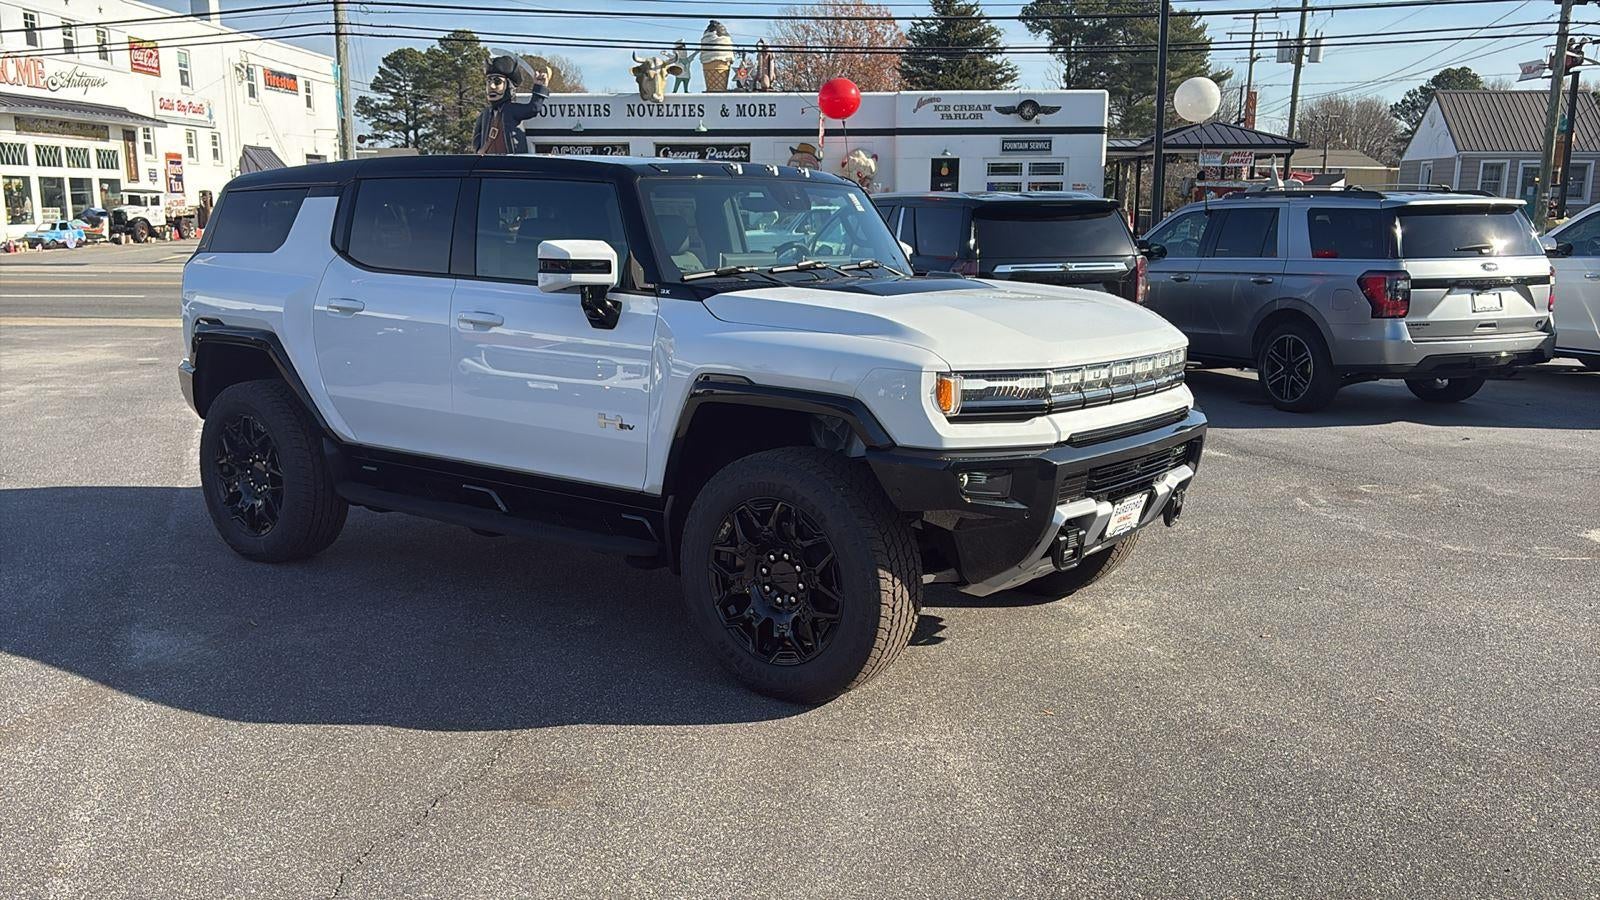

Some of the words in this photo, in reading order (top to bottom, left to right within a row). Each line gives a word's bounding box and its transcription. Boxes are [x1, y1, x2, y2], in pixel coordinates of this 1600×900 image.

[47, 66, 108, 95] Antiques
[264, 70, 298, 91] Firestone
[159, 97, 174, 111] Dutch
[177, 100, 188, 115] Boy
[188, 101, 205, 115] Paints
[540, 103, 611, 118] OUVENIRS
[626, 103, 705, 118] NOVELTIES
[720, 103, 730, 118] &
[736, 103, 777, 118] MORE
[933, 104, 951, 112] ICE
[953, 104, 992, 112] CREAM
[940, 112, 984, 120] PARLOR
[660, 146, 700, 159] Cream
[705, 146, 749, 160] Parlor
[1003, 142, 1029, 150] FOUNTAIN
[1029, 141, 1051, 150] SERVICE
[1062, 351, 1184, 384] HUMMER
